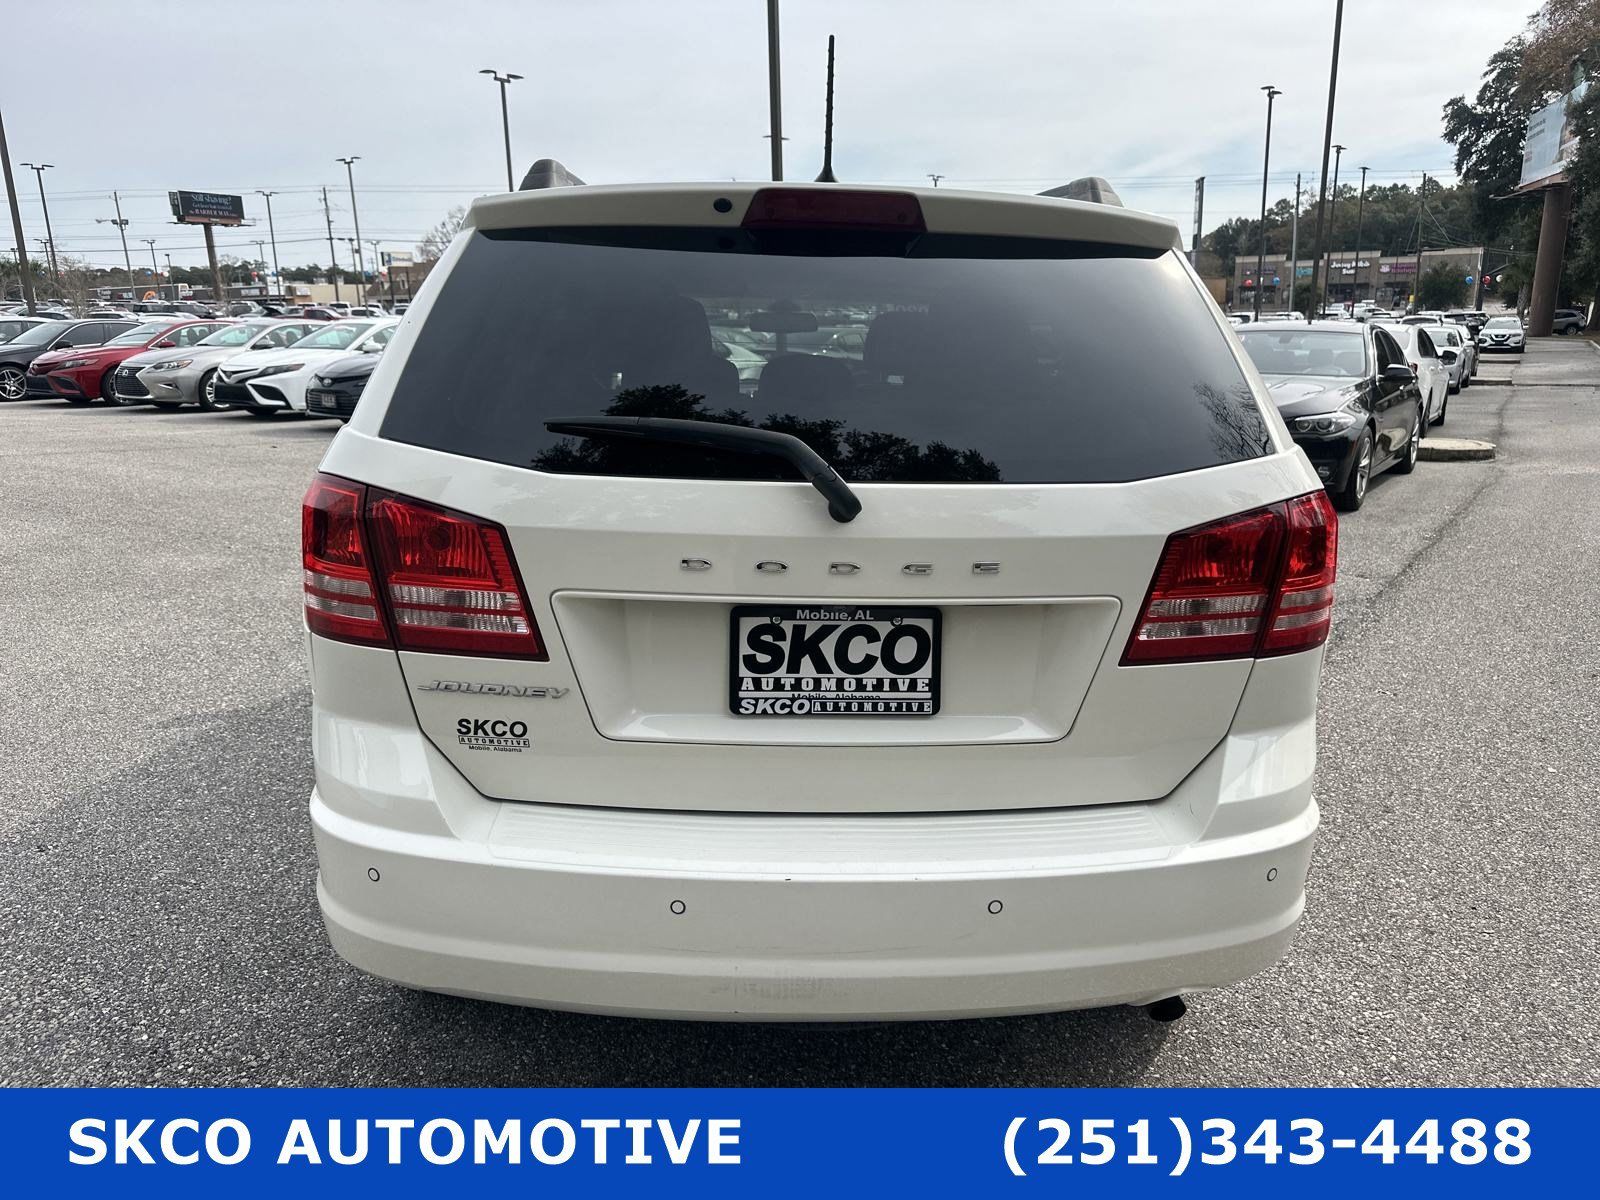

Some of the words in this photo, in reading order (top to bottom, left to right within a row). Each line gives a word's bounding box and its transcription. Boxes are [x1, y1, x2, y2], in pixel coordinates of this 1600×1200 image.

[680, 558, 1001, 576] DODGE
[796, 609, 852, 621] Mobile,
[854, 609, 874, 620] AL
[742, 623, 932, 676] SKCO
[417, 680, 570, 699] JOURNEY
[741, 677, 930, 691] AUTOMOTIVE
[738, 699, 811, 715] SKCO
[814, 702, 931, 712] AUTOMOTIVE
[456, 718, 528, 738] SKCO
[460, 736, 529, 746] AUTOMOTIVE
